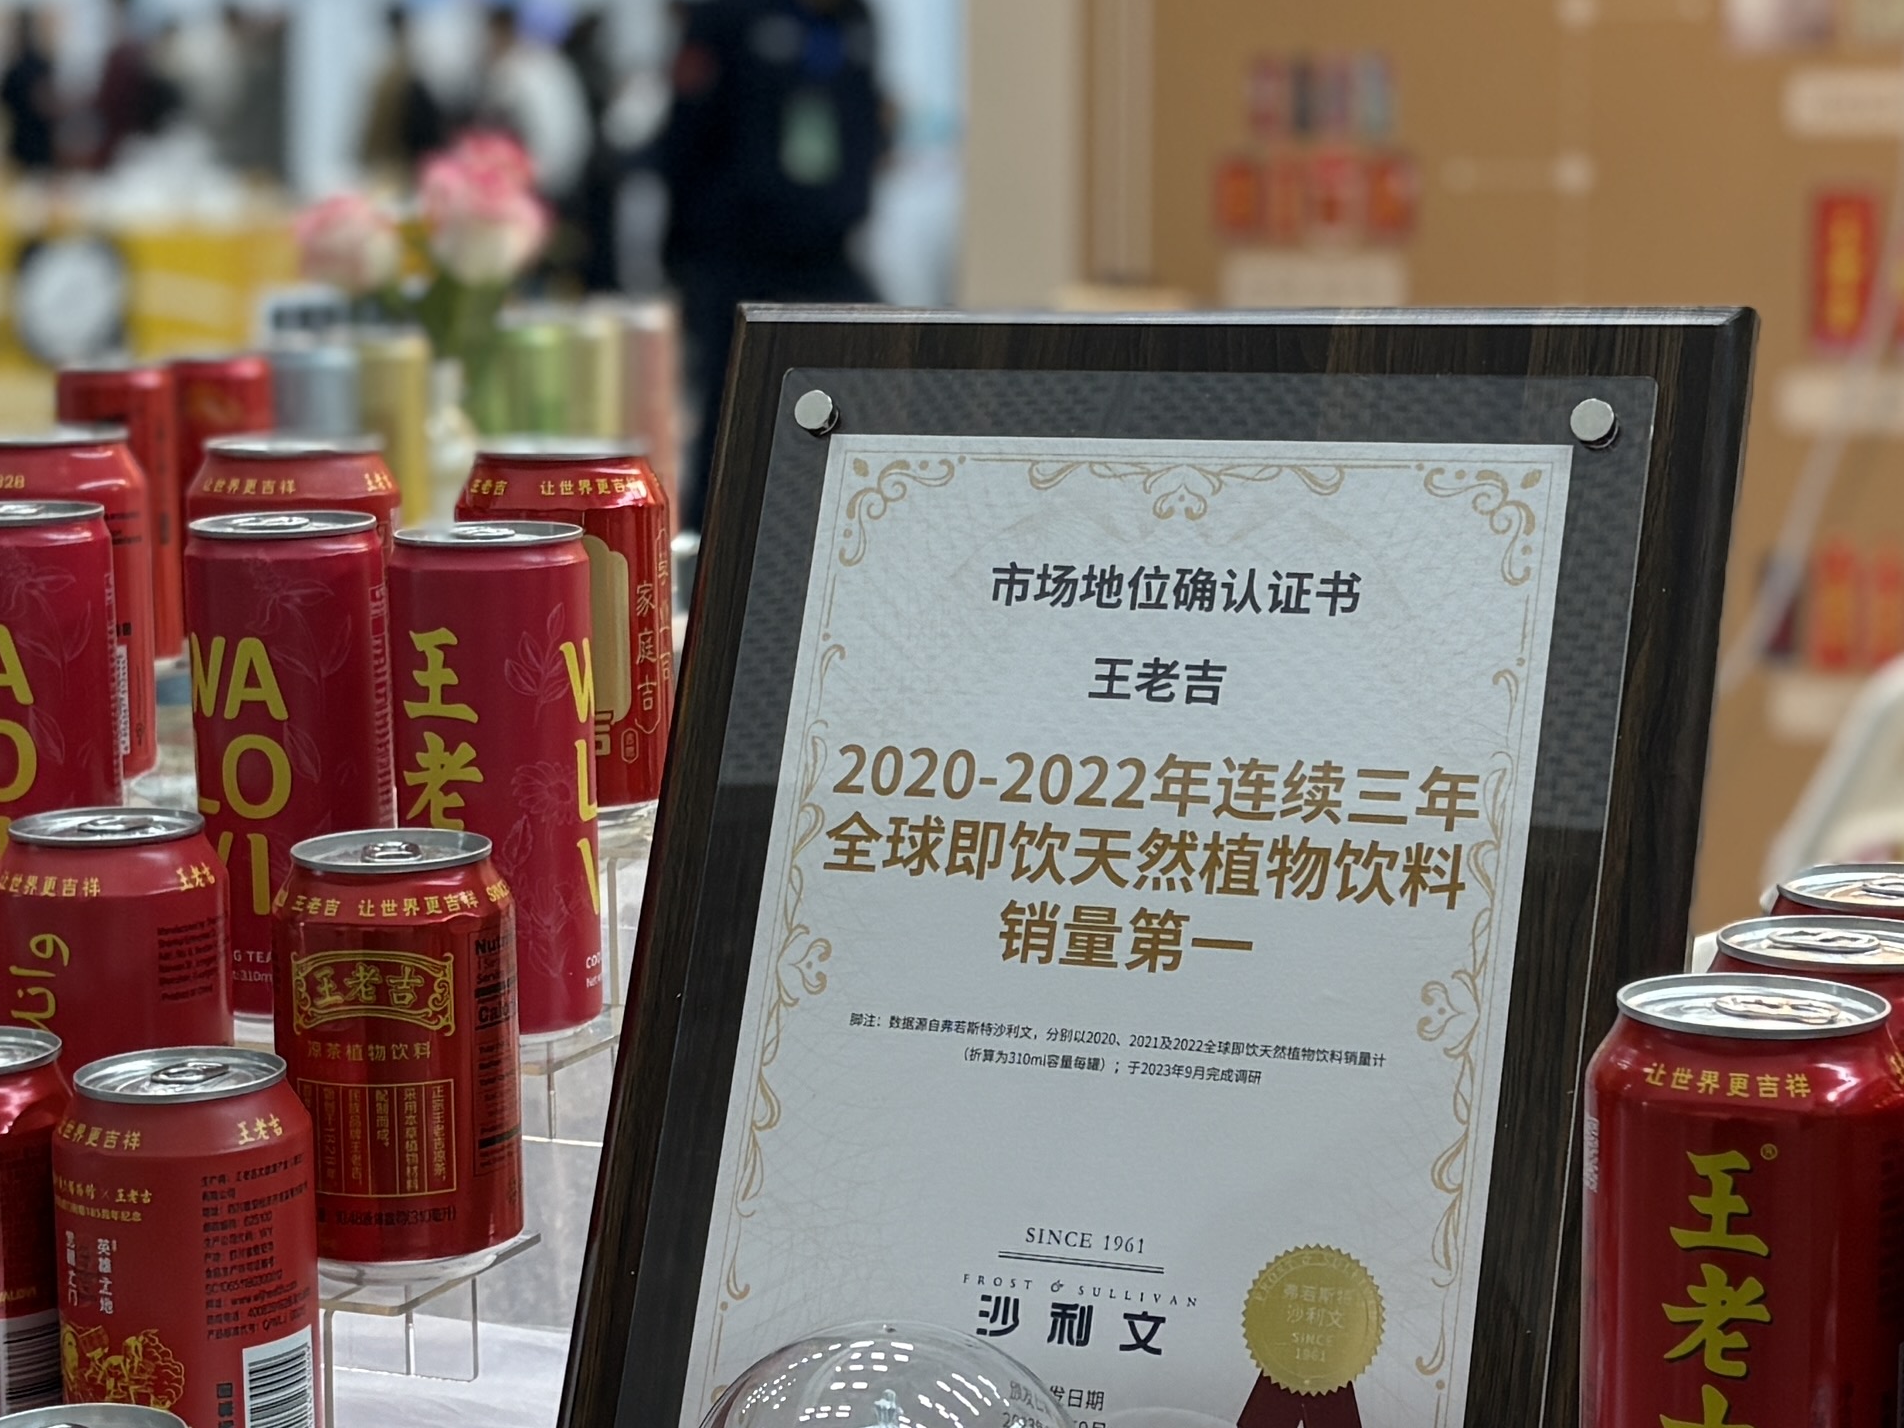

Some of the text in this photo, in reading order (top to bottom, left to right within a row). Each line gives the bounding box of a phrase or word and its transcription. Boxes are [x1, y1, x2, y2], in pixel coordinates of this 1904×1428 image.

[991, 561, 1362, 617] 市场地位确认证书
[1087, 656, 1228, 706] 王老吉
[832, 743, 1480, 832] 2020-2022年连续三年
[823, 811, 1467, 910] 全球即饮天然植物饮料
[292, 897, 341, 918] 王老吉
[358, 891, 479, 919] 让世界更吉祥
[999, 899, 1254, 973] 销量第一
[312, 963, 425, 1008] 王老吉
[307, 1040, 433, 1062] 凉茶植物饮料
[1646, 1063, 1812, 1100] 让世界更吉祥
[239, 1115, 284, 1145] 王老吉
[115, 1188, 153, 1205] 王老吉
[1025, 1227, 1145, 1254] SINCE 1961
[963, 1273, 1033, 1290] FROST
[1079, 1285, 1198, 1308] SULLIVAN
[976, 1294, 1167, 1356] 沙利文
